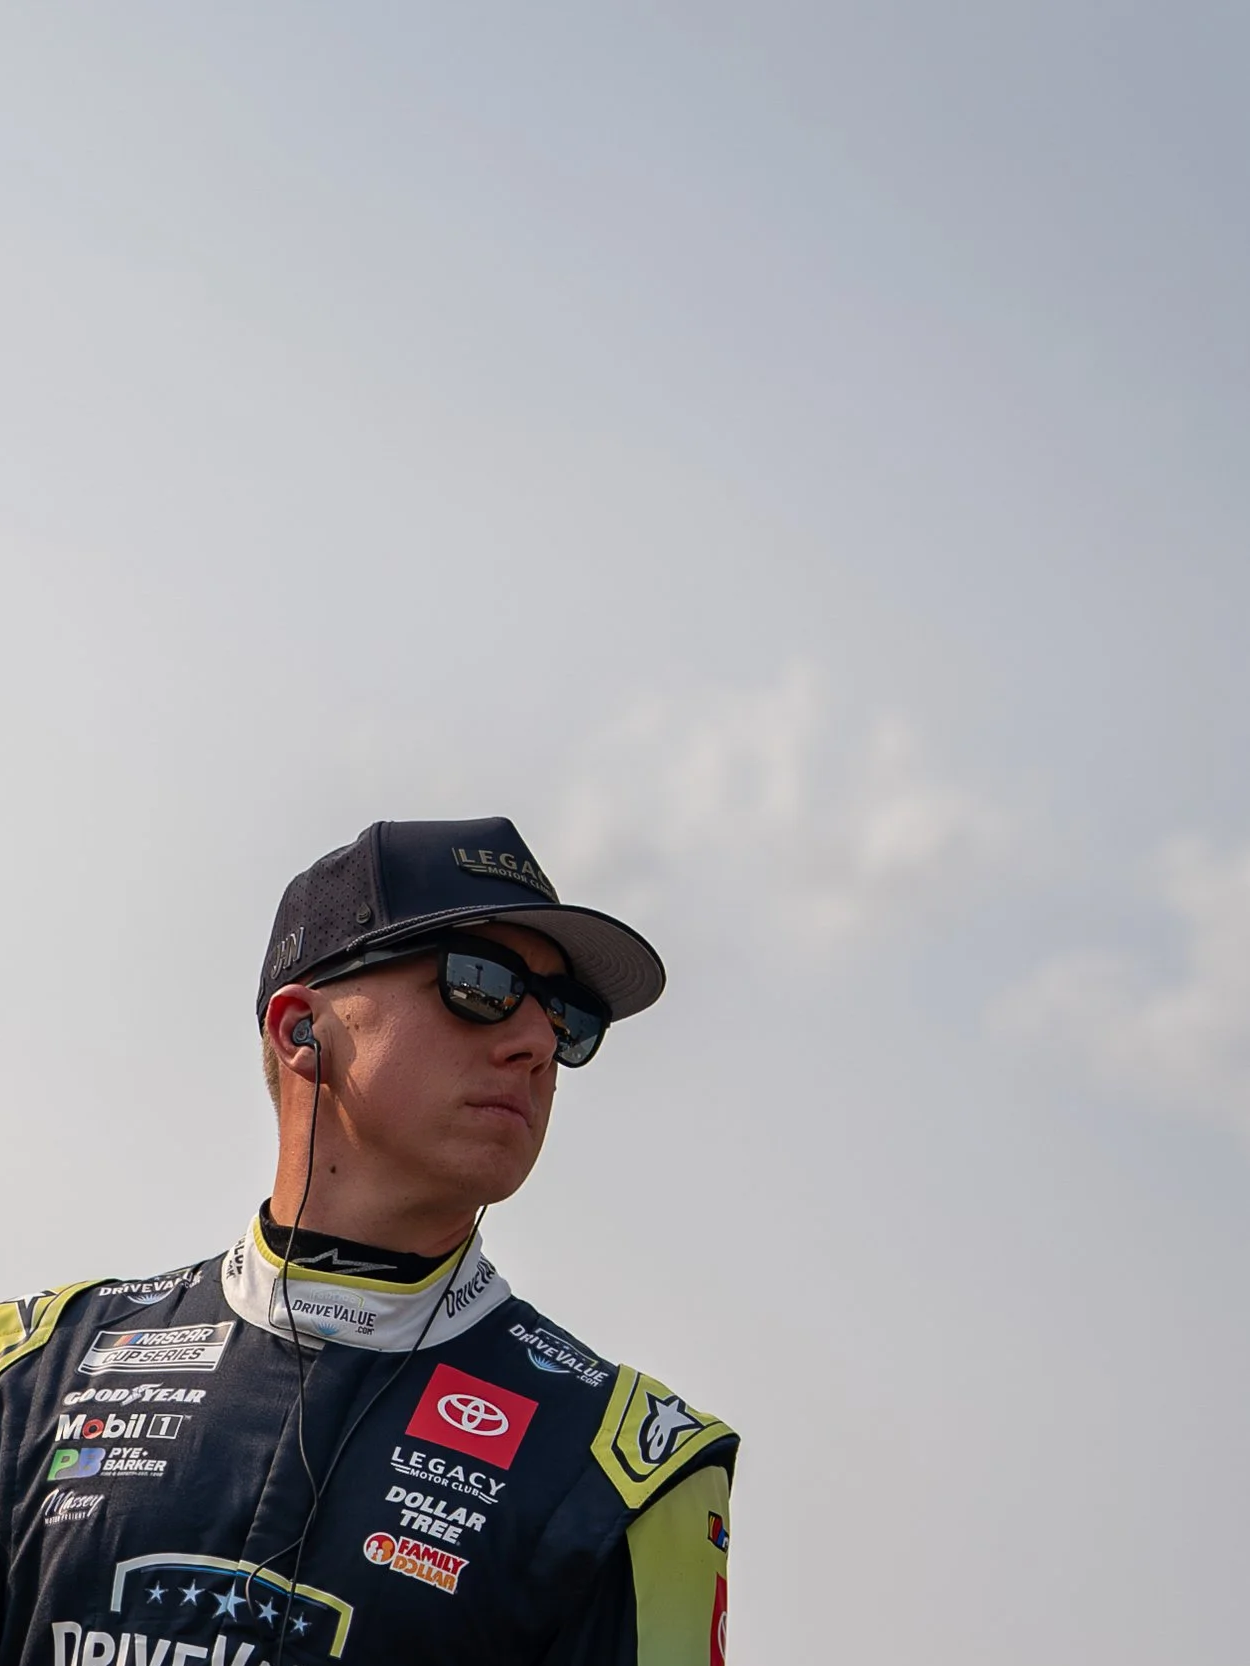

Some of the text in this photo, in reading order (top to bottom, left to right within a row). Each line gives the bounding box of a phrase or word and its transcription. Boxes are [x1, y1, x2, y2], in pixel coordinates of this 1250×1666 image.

[291, 1299, 377, 1327] DRIVEVALUE
[136, 1328, 214, 1346] NASCAR
[103, 1348, 206, 1364] CUP SERIES
[508, 1323, 609, 1383] DRIVEVALUE
[63, 1382, 207, 1406] GOODYEAR
[55, 1413, 147, 1441] Mobil
[102, 1459, 168, 1472] BARKER
[391, 1446, 506, 1497] LEGACY
[409, 1469, 480, 1497] MOTOR CLUB
[385, 1486, 486, 1532] DOLLAR
[399, 1509, 463, 1545] TREE
[397, 1538, 466, 1576] FAMILY
[392, 1556, 457, 1592] DOLLAR
